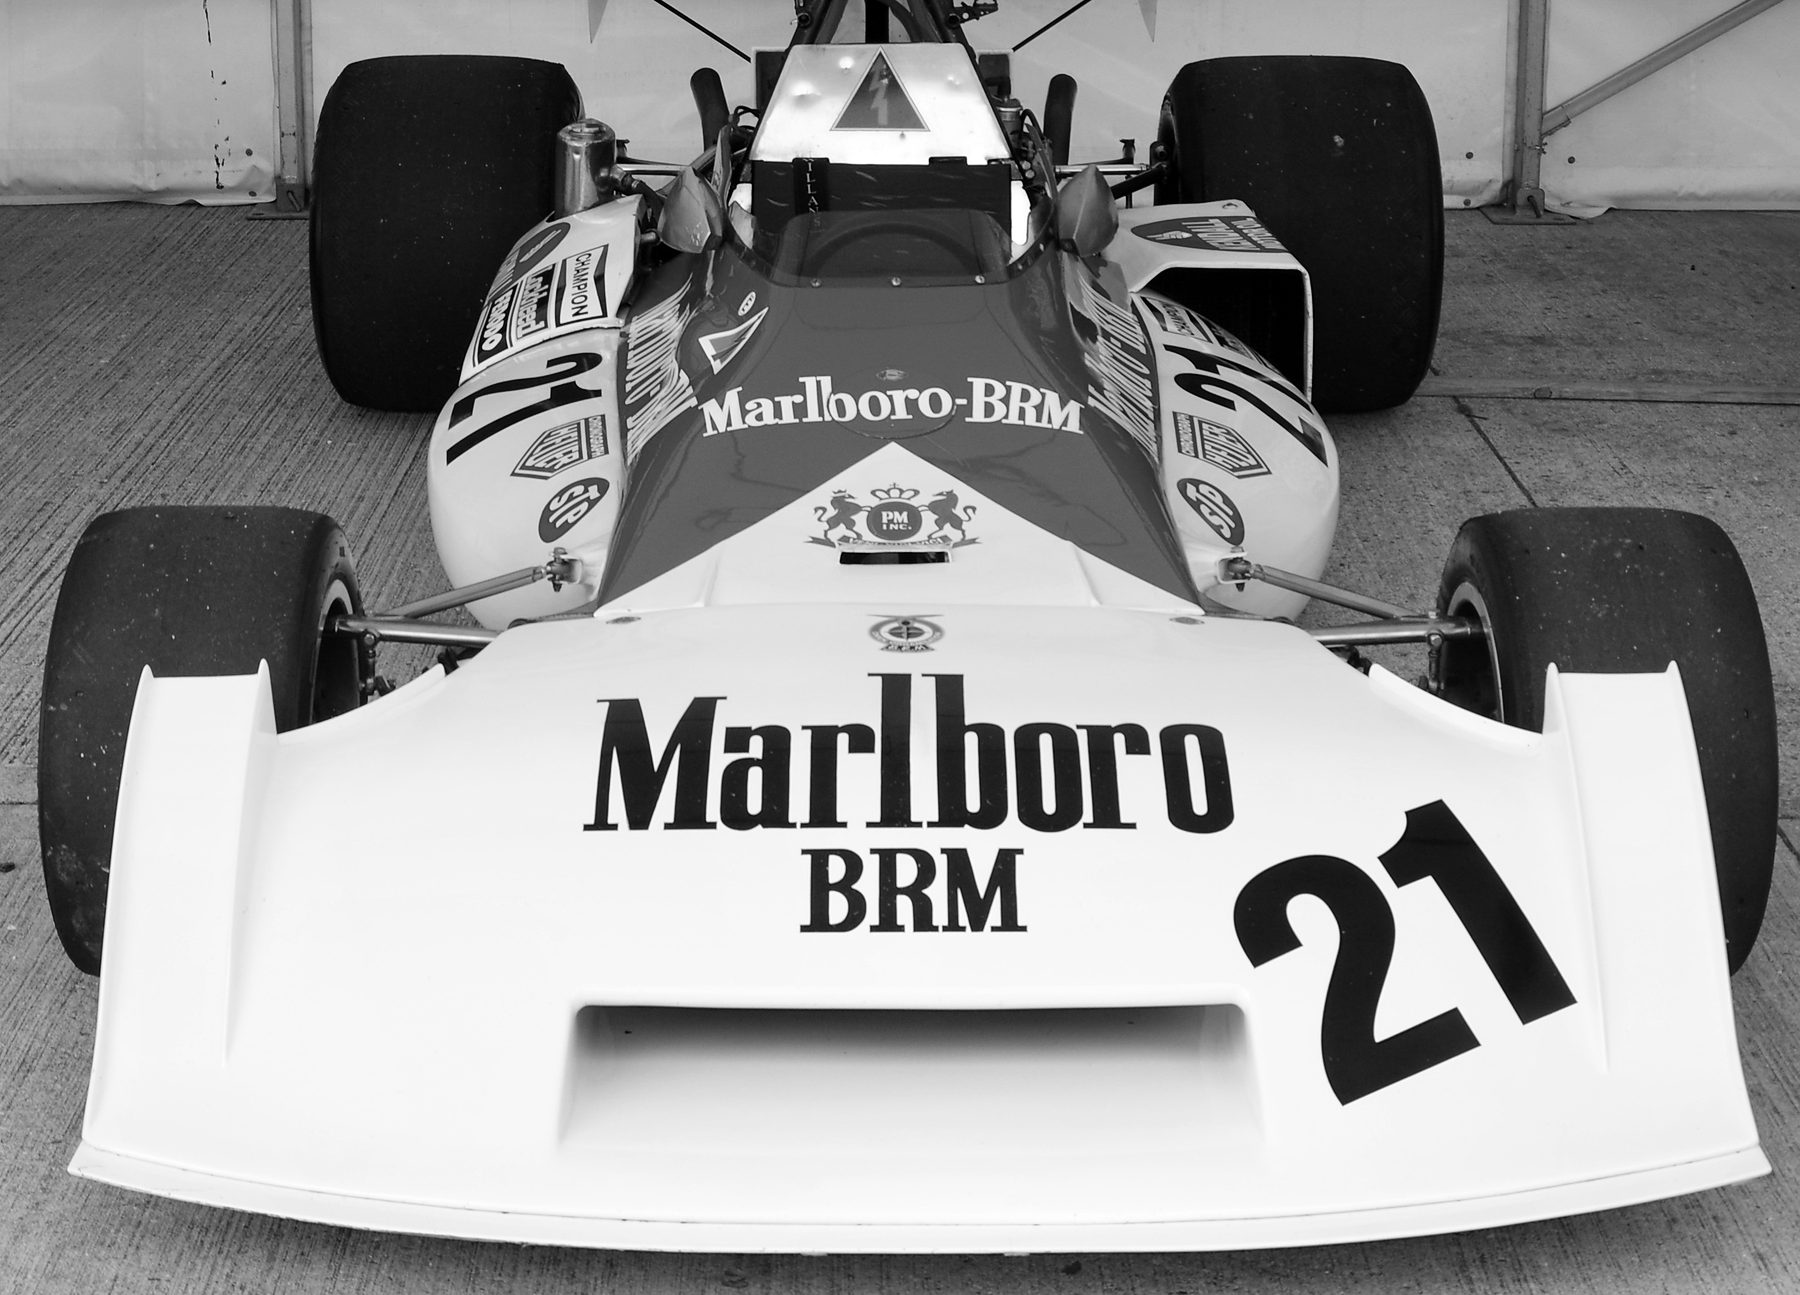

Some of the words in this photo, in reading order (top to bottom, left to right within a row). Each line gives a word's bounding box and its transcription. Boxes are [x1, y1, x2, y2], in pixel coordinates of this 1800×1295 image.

[516, 263, 555, 340] Lockheed
[571, 253, 592, 318] CHAMPION
[481, 289, 514, 351] FERODO
[447, 352, 603, 466] 21
[698, 375, 1084, 438] Marlboro-BRM
[1162, 343, 1329, 468] 21
[525, 424, 580, 470] HEUER
[1201, 421, 1259, 470] HEUER
[549, 484, 601, 529] STP
[881, 511, 909, 524] PM
[882, 523, 912, 531] INC.
[1186, 482, 1236, 539] STP
[583, 673, 1235, 834] Marlboro
[800, 848, 1028, 933] BRM
[1233, 798, 1578, 1106] 21
